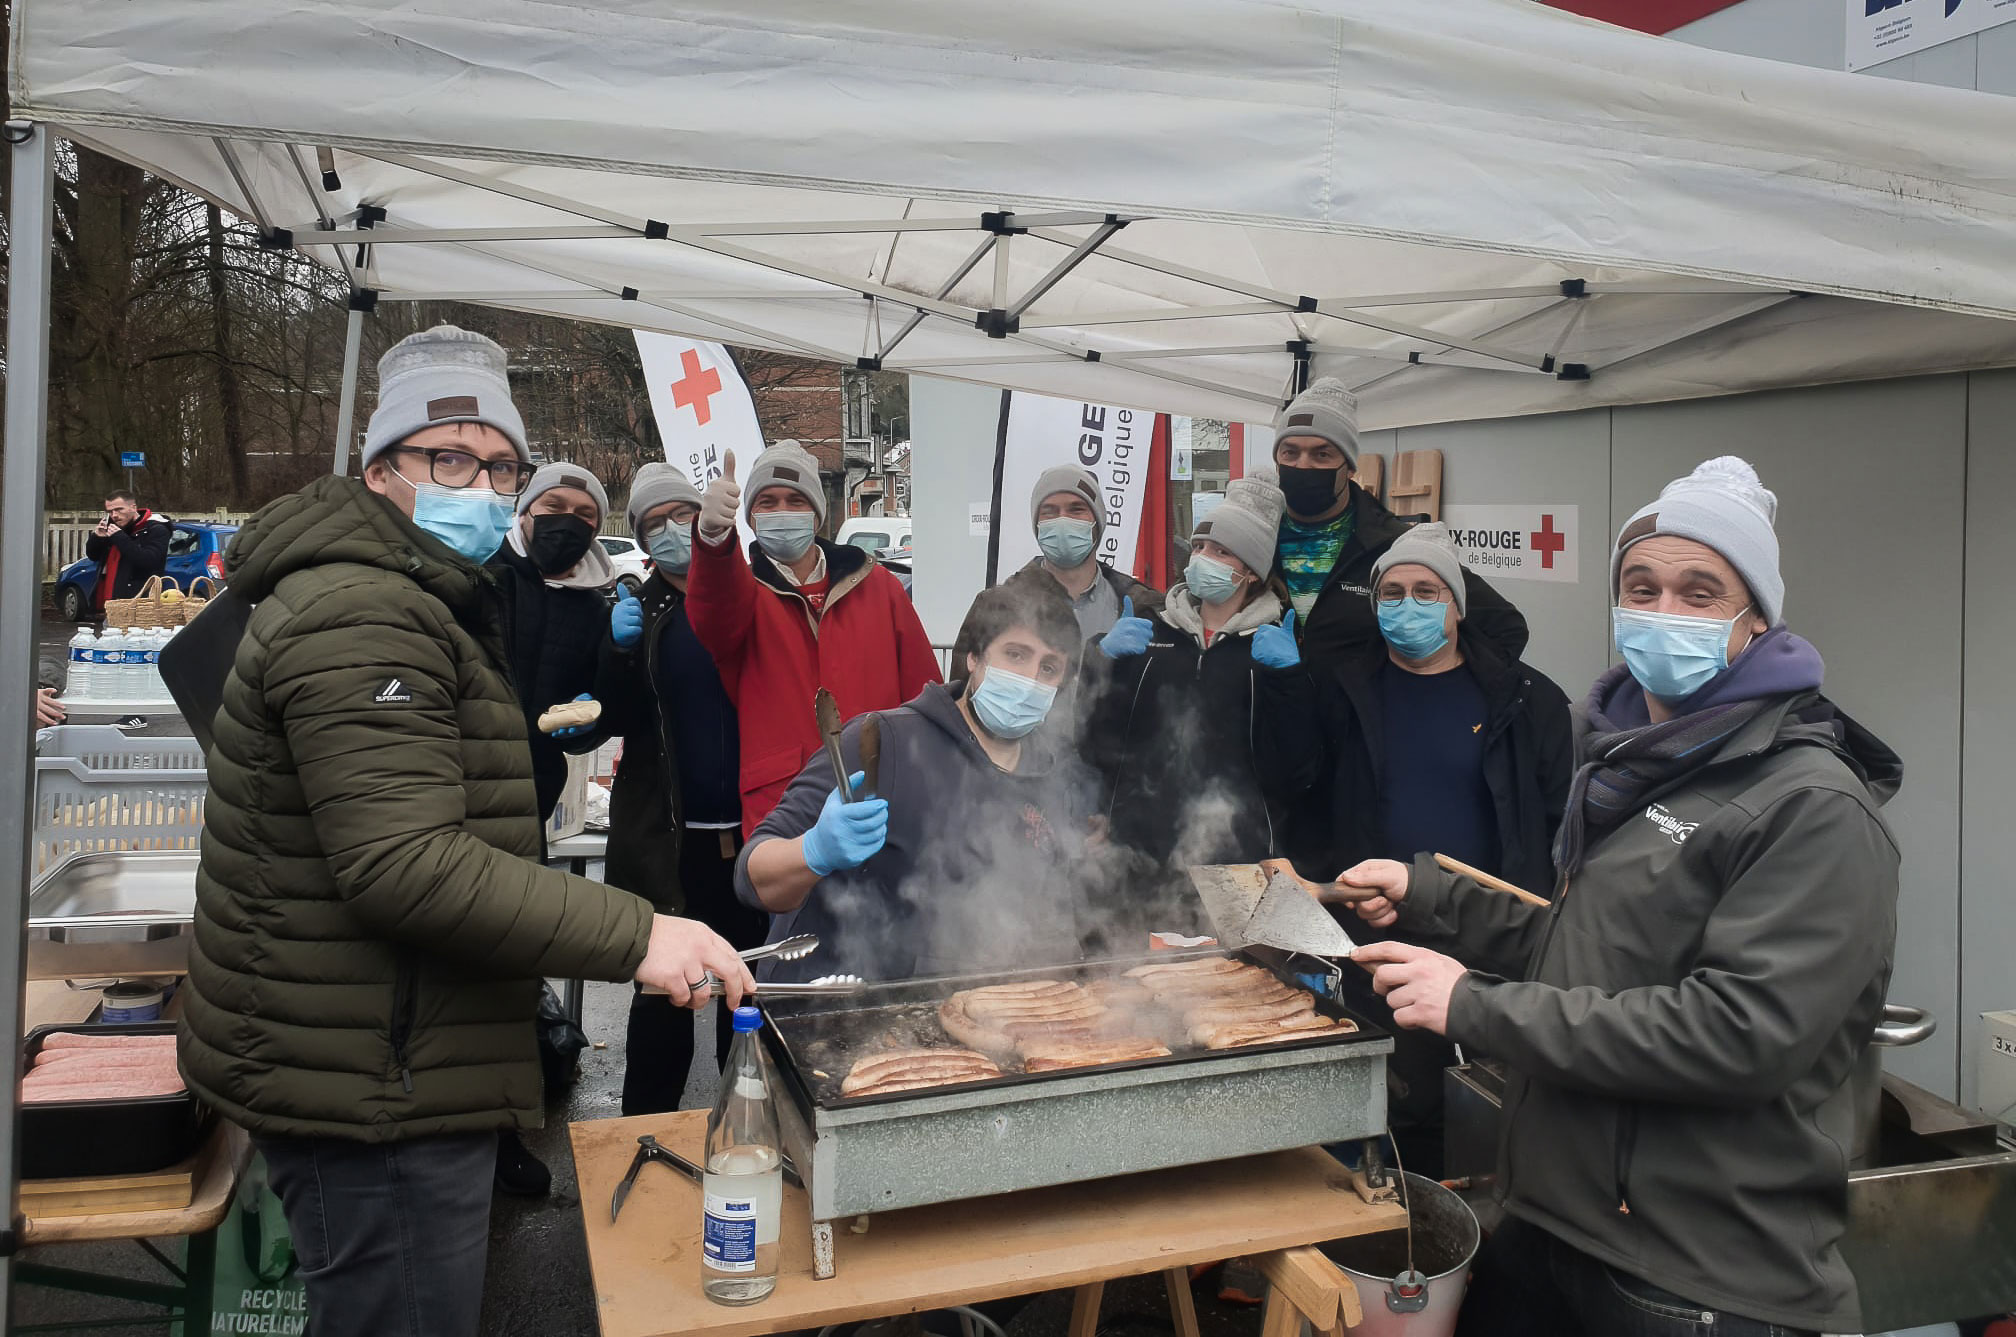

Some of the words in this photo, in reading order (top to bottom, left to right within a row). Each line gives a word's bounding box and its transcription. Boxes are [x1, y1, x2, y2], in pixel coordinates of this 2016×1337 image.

[1105, 409, 1134, 528] Belgique
[1468, 552, 1482, 564] de
[1482, 552, 1522, 569] Belgique
[240, 1285, 307, 1311] RECYCLÉ
[211, 1311, 309, 1336] ATURELLEM
